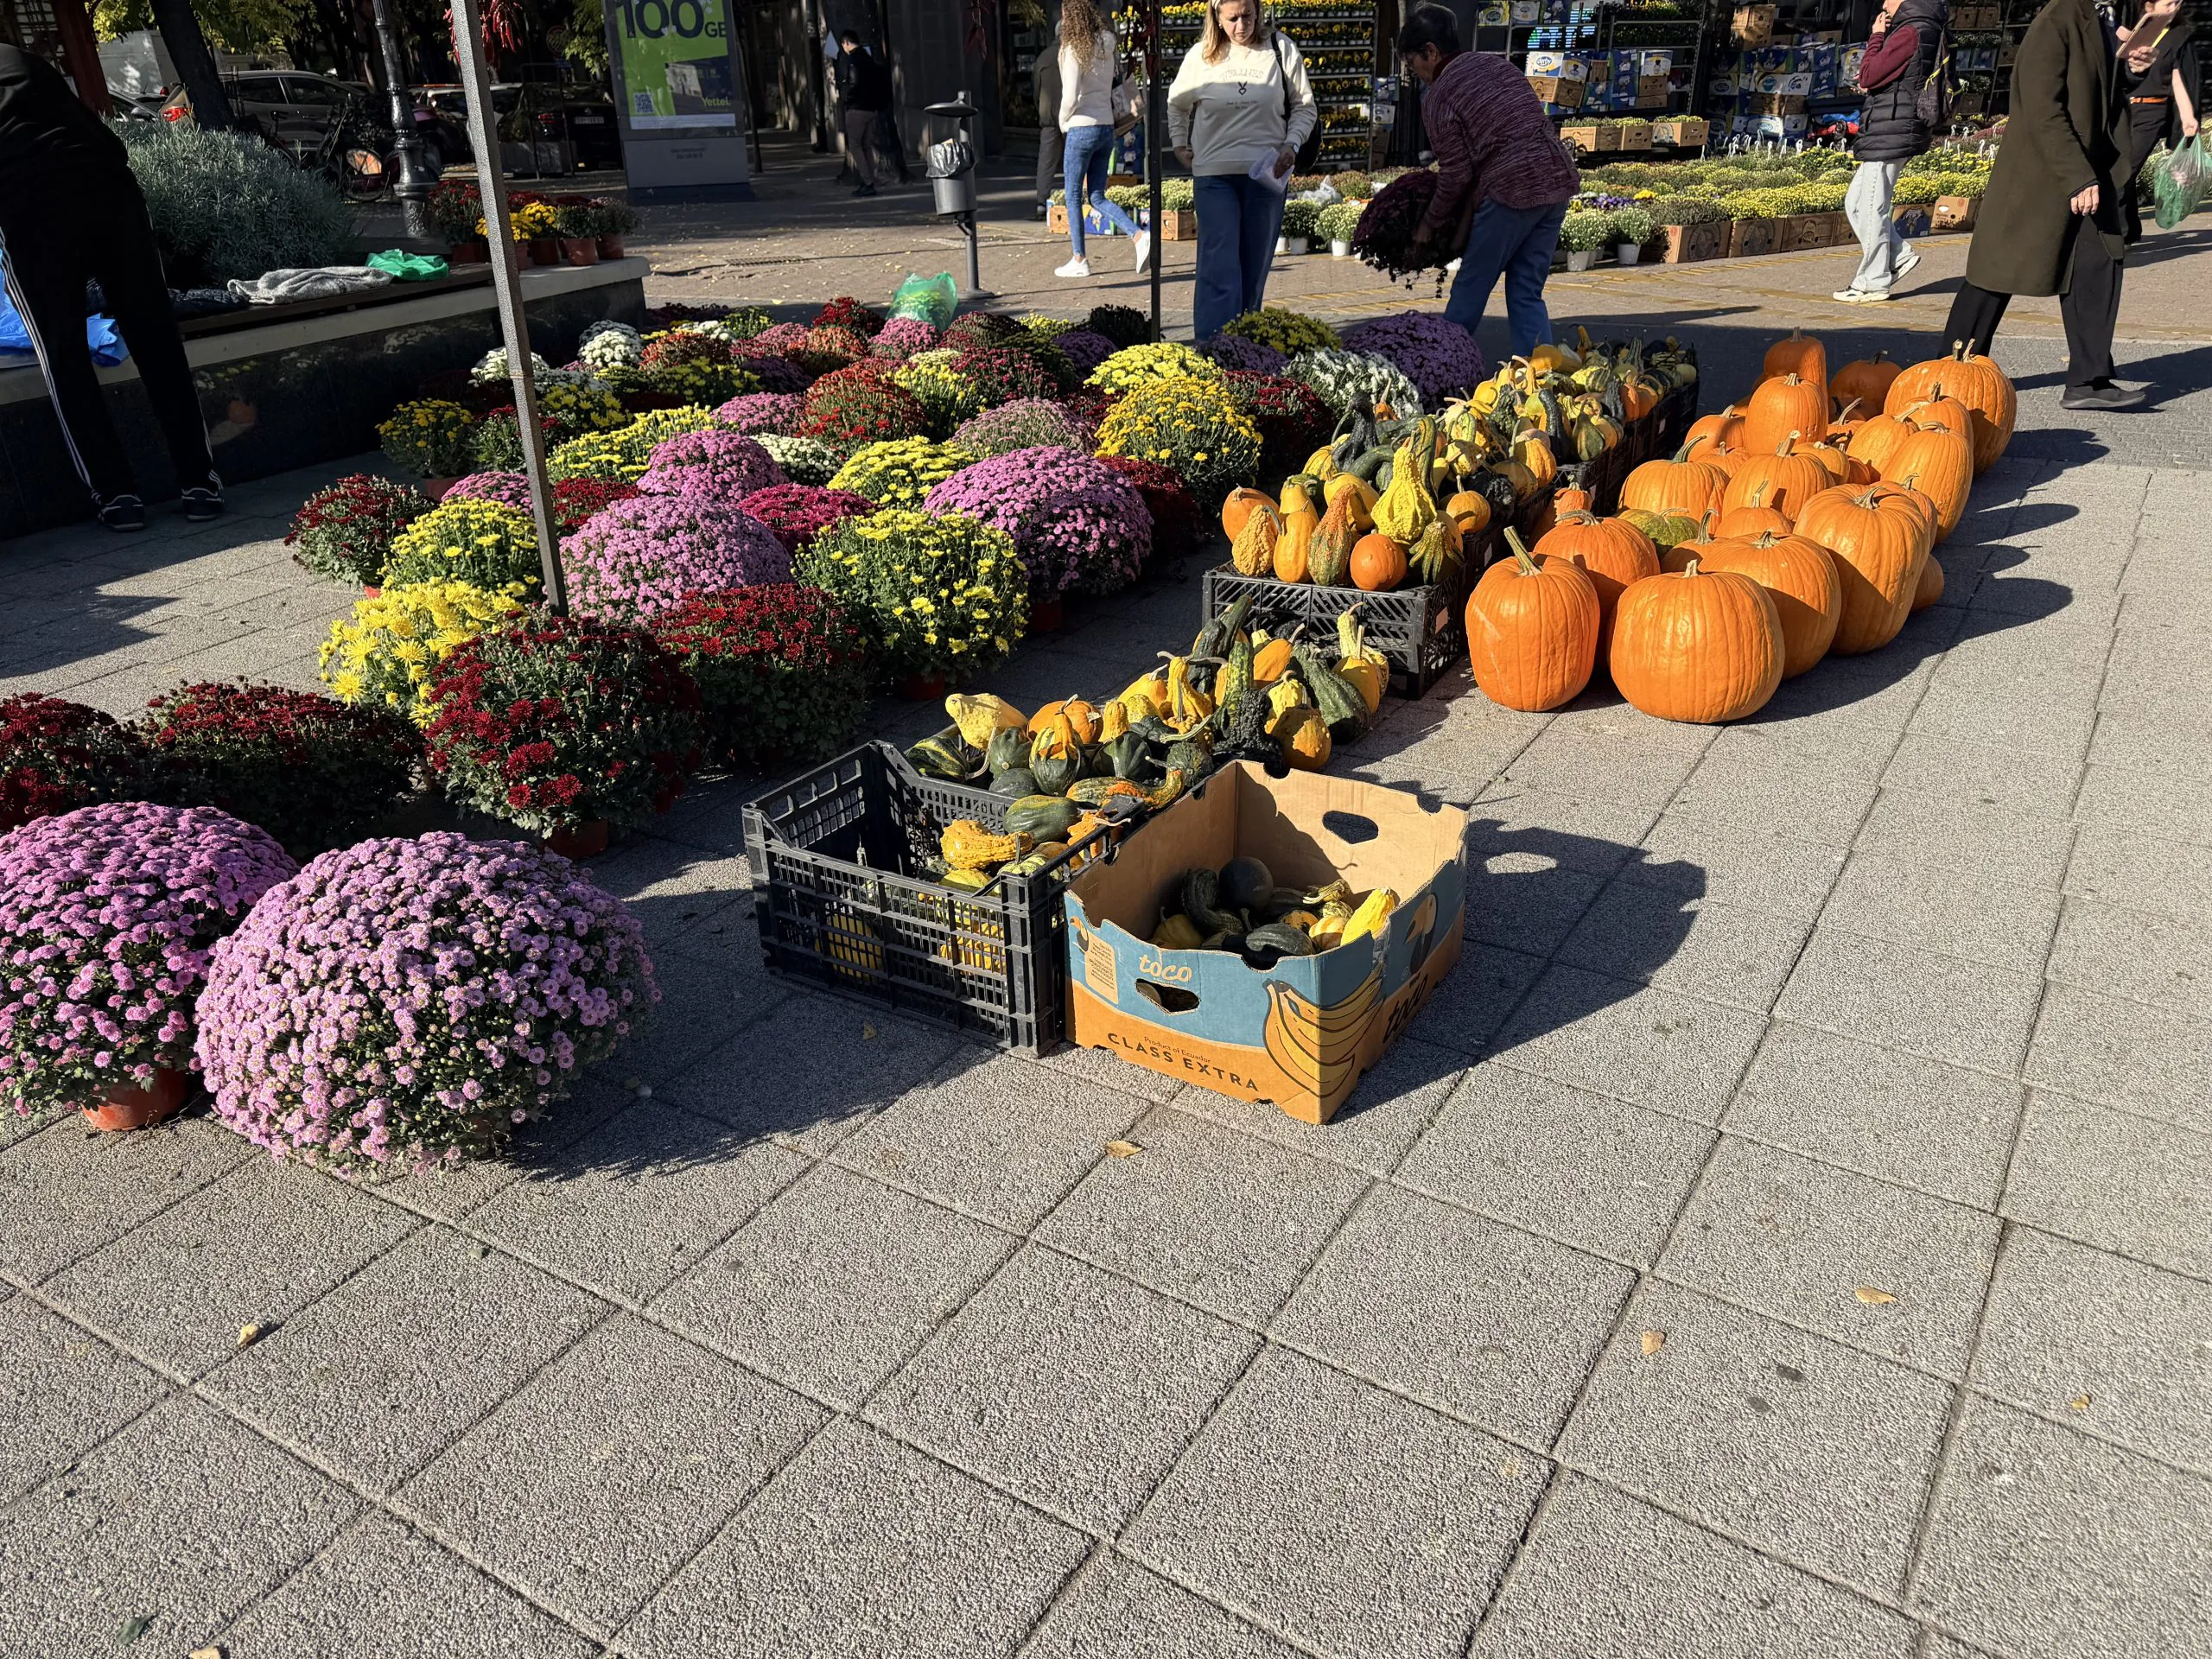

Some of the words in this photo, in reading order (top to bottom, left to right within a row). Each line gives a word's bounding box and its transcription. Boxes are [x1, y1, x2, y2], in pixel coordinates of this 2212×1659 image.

[1139, 954, 1192, 982] toco
[1107, 1033, 1173, 1063] CLASS
[1183, 1058, 1259, 1092] EXTRA
[1143, 1036, 1171, 1051] Product
[1181, 1049, 1211, 1063] Ecuador
